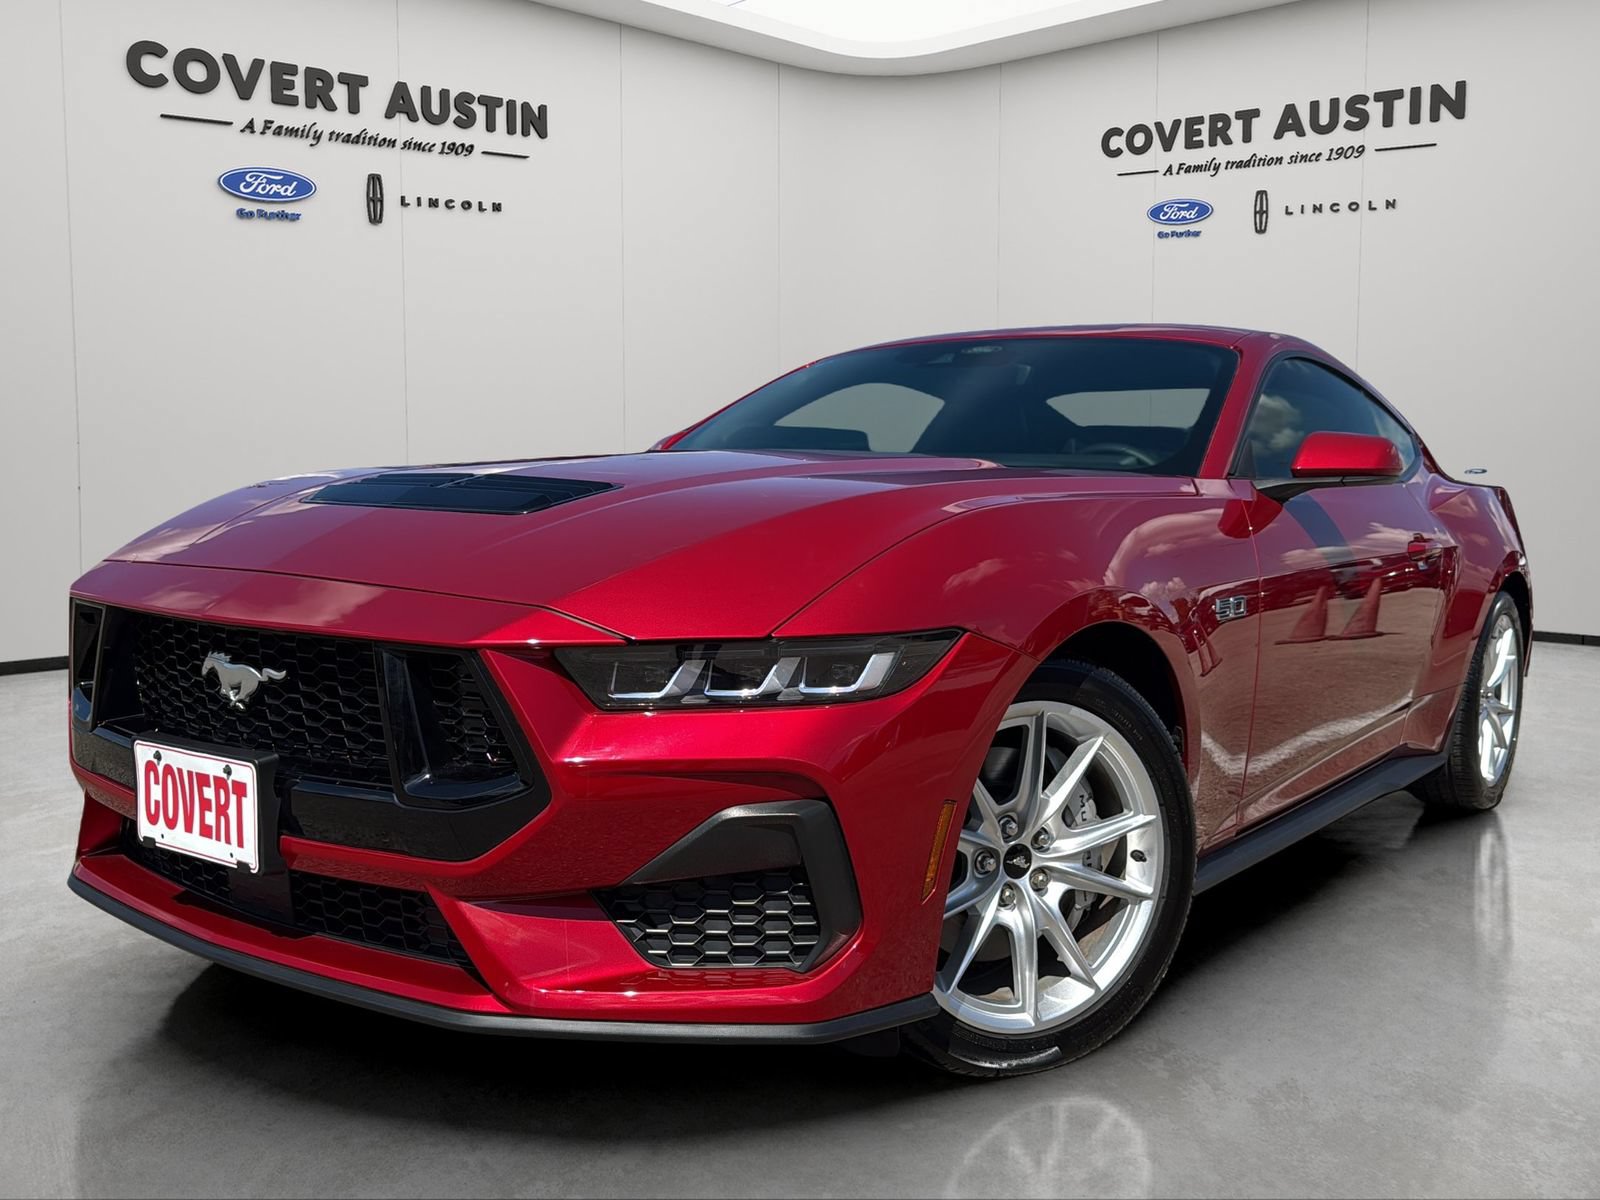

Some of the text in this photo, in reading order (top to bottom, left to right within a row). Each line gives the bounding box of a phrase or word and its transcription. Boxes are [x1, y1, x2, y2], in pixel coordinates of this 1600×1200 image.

[125, 40, 549, 139] COVERT AUSTIN
[1100, 80, 1467, 159] COVERT AUSTIN
[239, 117, 475, 157] A Family tradition since 1909
[1162, 144, 1366, 177] A Family tradition since 1909
[239, 172, 298, 197] Ford
[236, 207, 255, 219] Go
[400, 195, 503, 213] LINCOLN
[1160, 203, 1200, 220] Ford
[1284, 198, 1398, 216] LINCOLN
[1157, 229, 1202, 239] Go Further
[144, 759, 248, 849] COVERT
